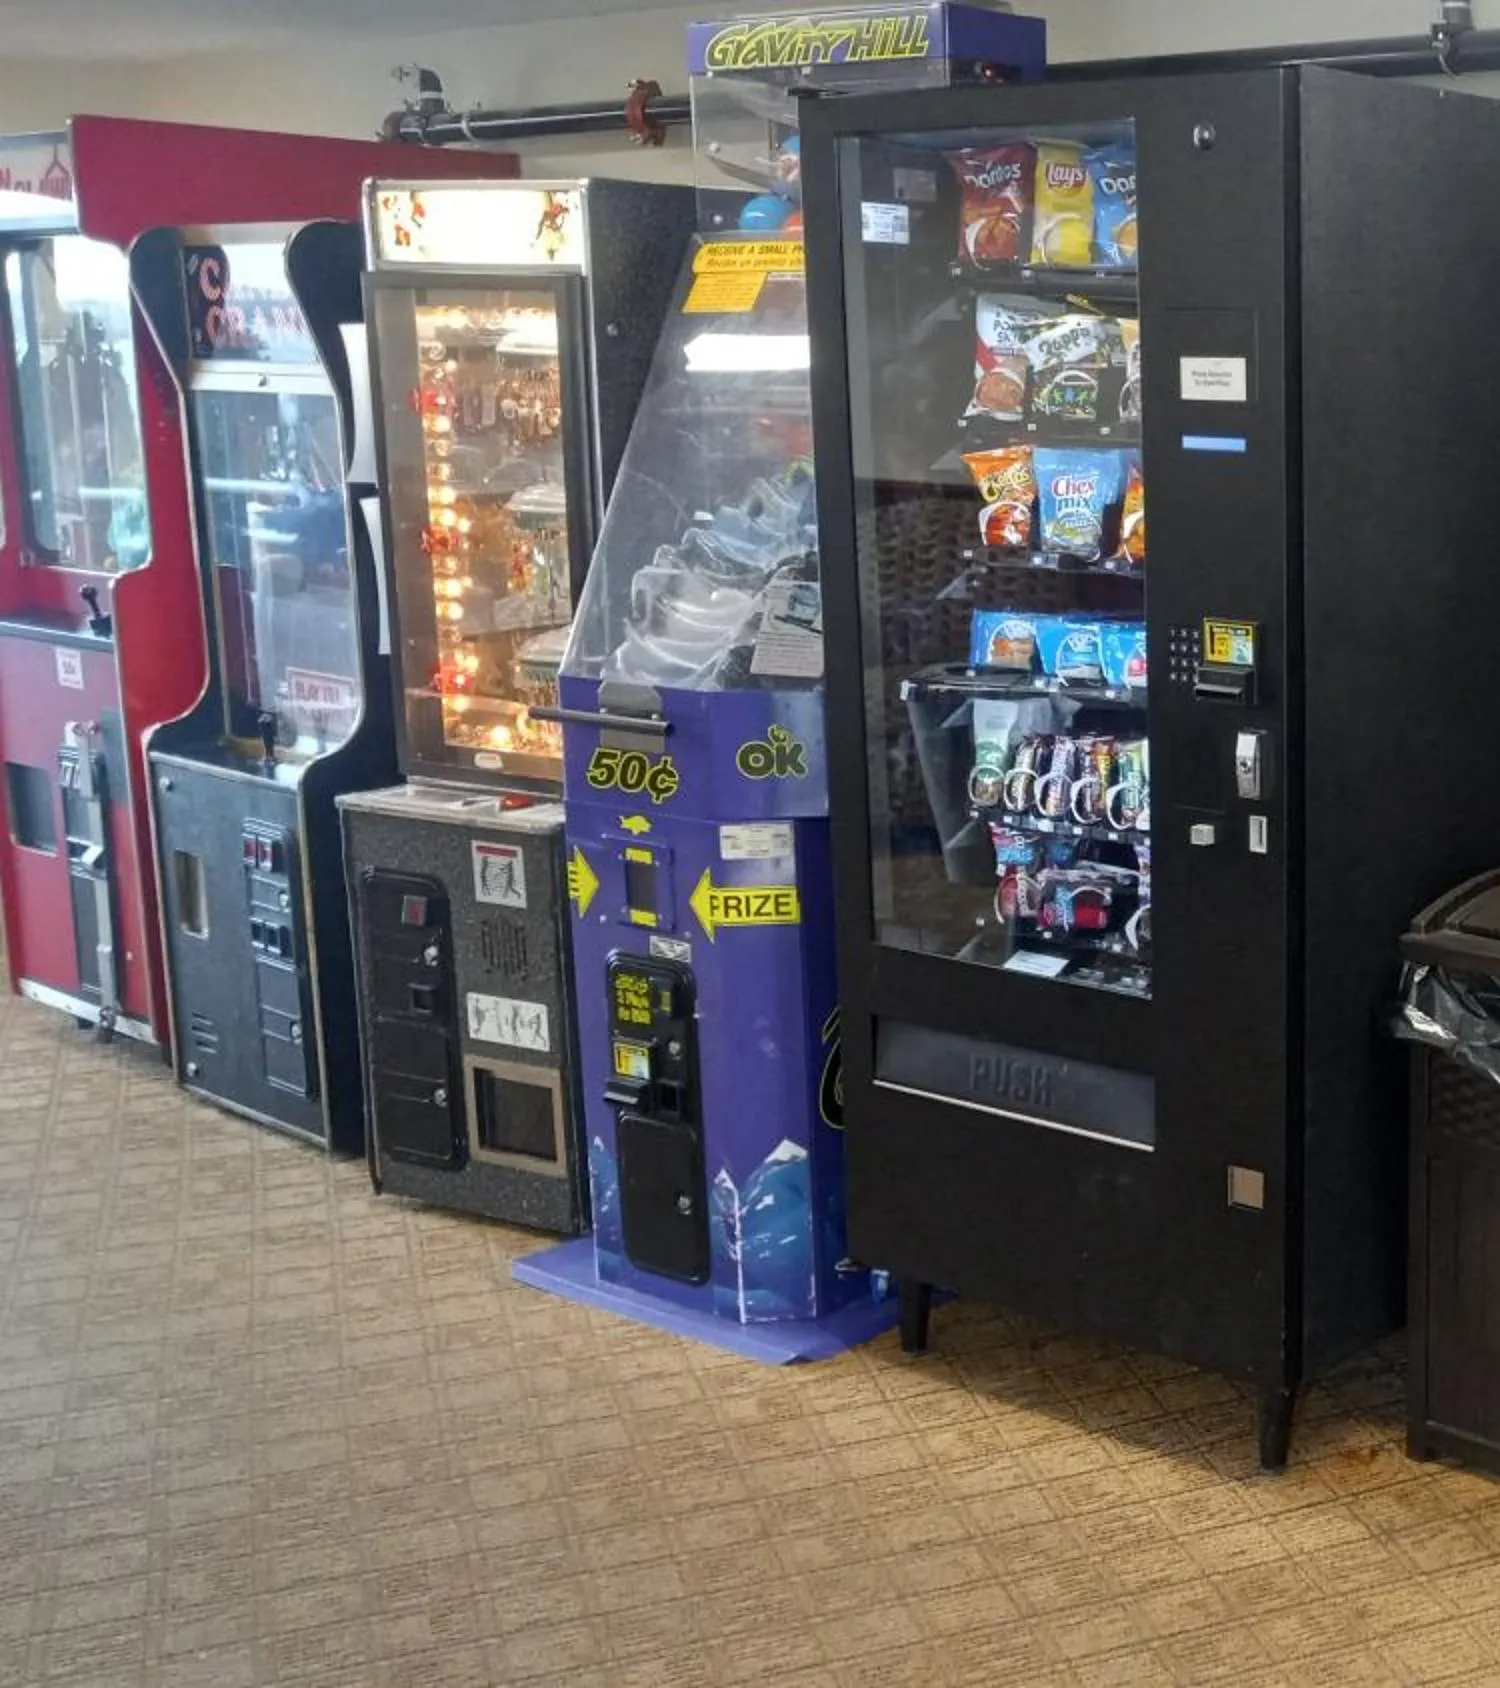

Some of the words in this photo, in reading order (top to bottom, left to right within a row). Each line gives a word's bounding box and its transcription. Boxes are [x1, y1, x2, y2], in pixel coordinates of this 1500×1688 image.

[845, 15, 929, 62] HILL
[1051, 475, 1097, 499] Chex
[586, 747, 679, 805] 50¢
